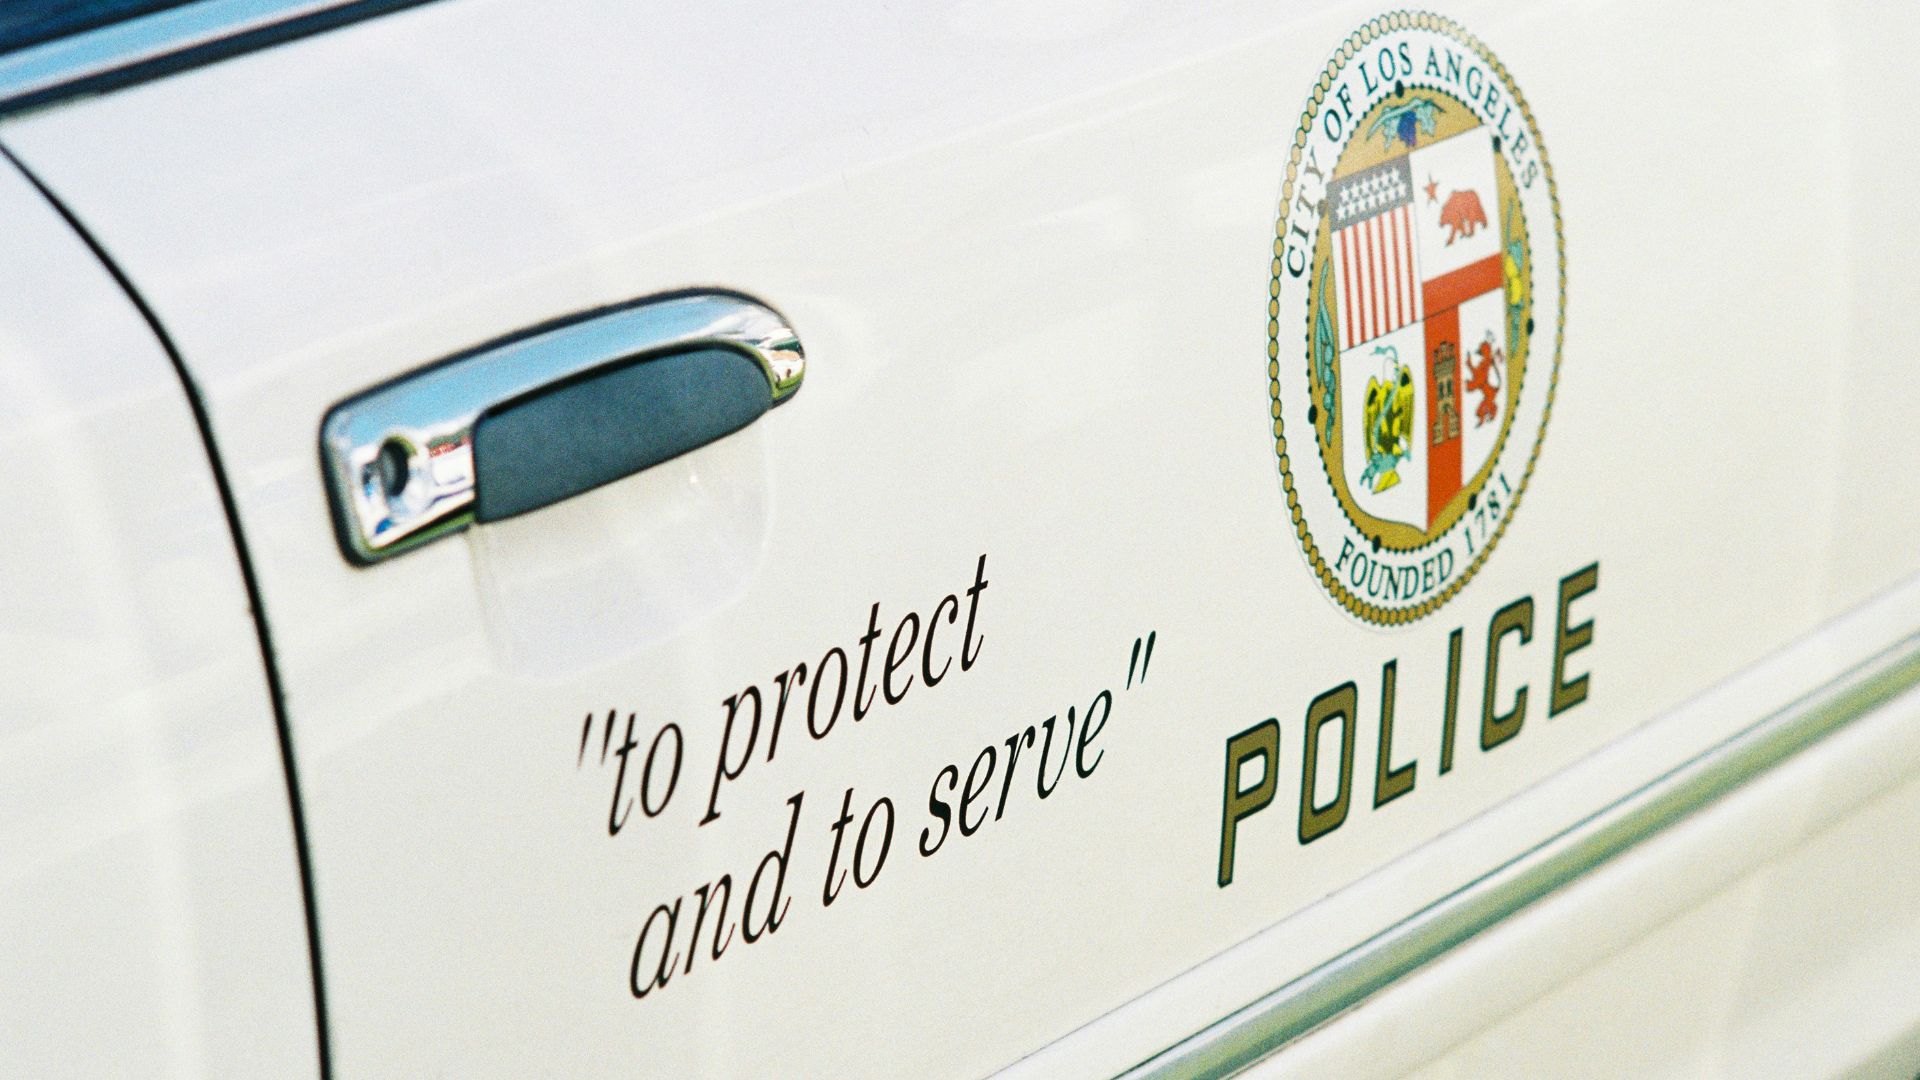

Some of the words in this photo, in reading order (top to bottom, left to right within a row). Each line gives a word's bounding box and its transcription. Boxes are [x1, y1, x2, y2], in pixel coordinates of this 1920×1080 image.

[1286, 146, 1325, 278] CITY
[1324, 83, 1354, 143] OF
[1358, 41, 1413, 96] LOS
[1425, 46, 1539, 189] ANGELES
[1334, 535, 1454, 600] FOUNDED
[1465, 472, 1512, 554] 1781
[577, 708, 684, 838] "to
[698, 553, 989, 828] protect
[630, 790, 804, 999] and
[822, 787, 895, 907] to
[919, 630, 1157, 858] serve"
[1217, 560, 1599, 889] POLICE
